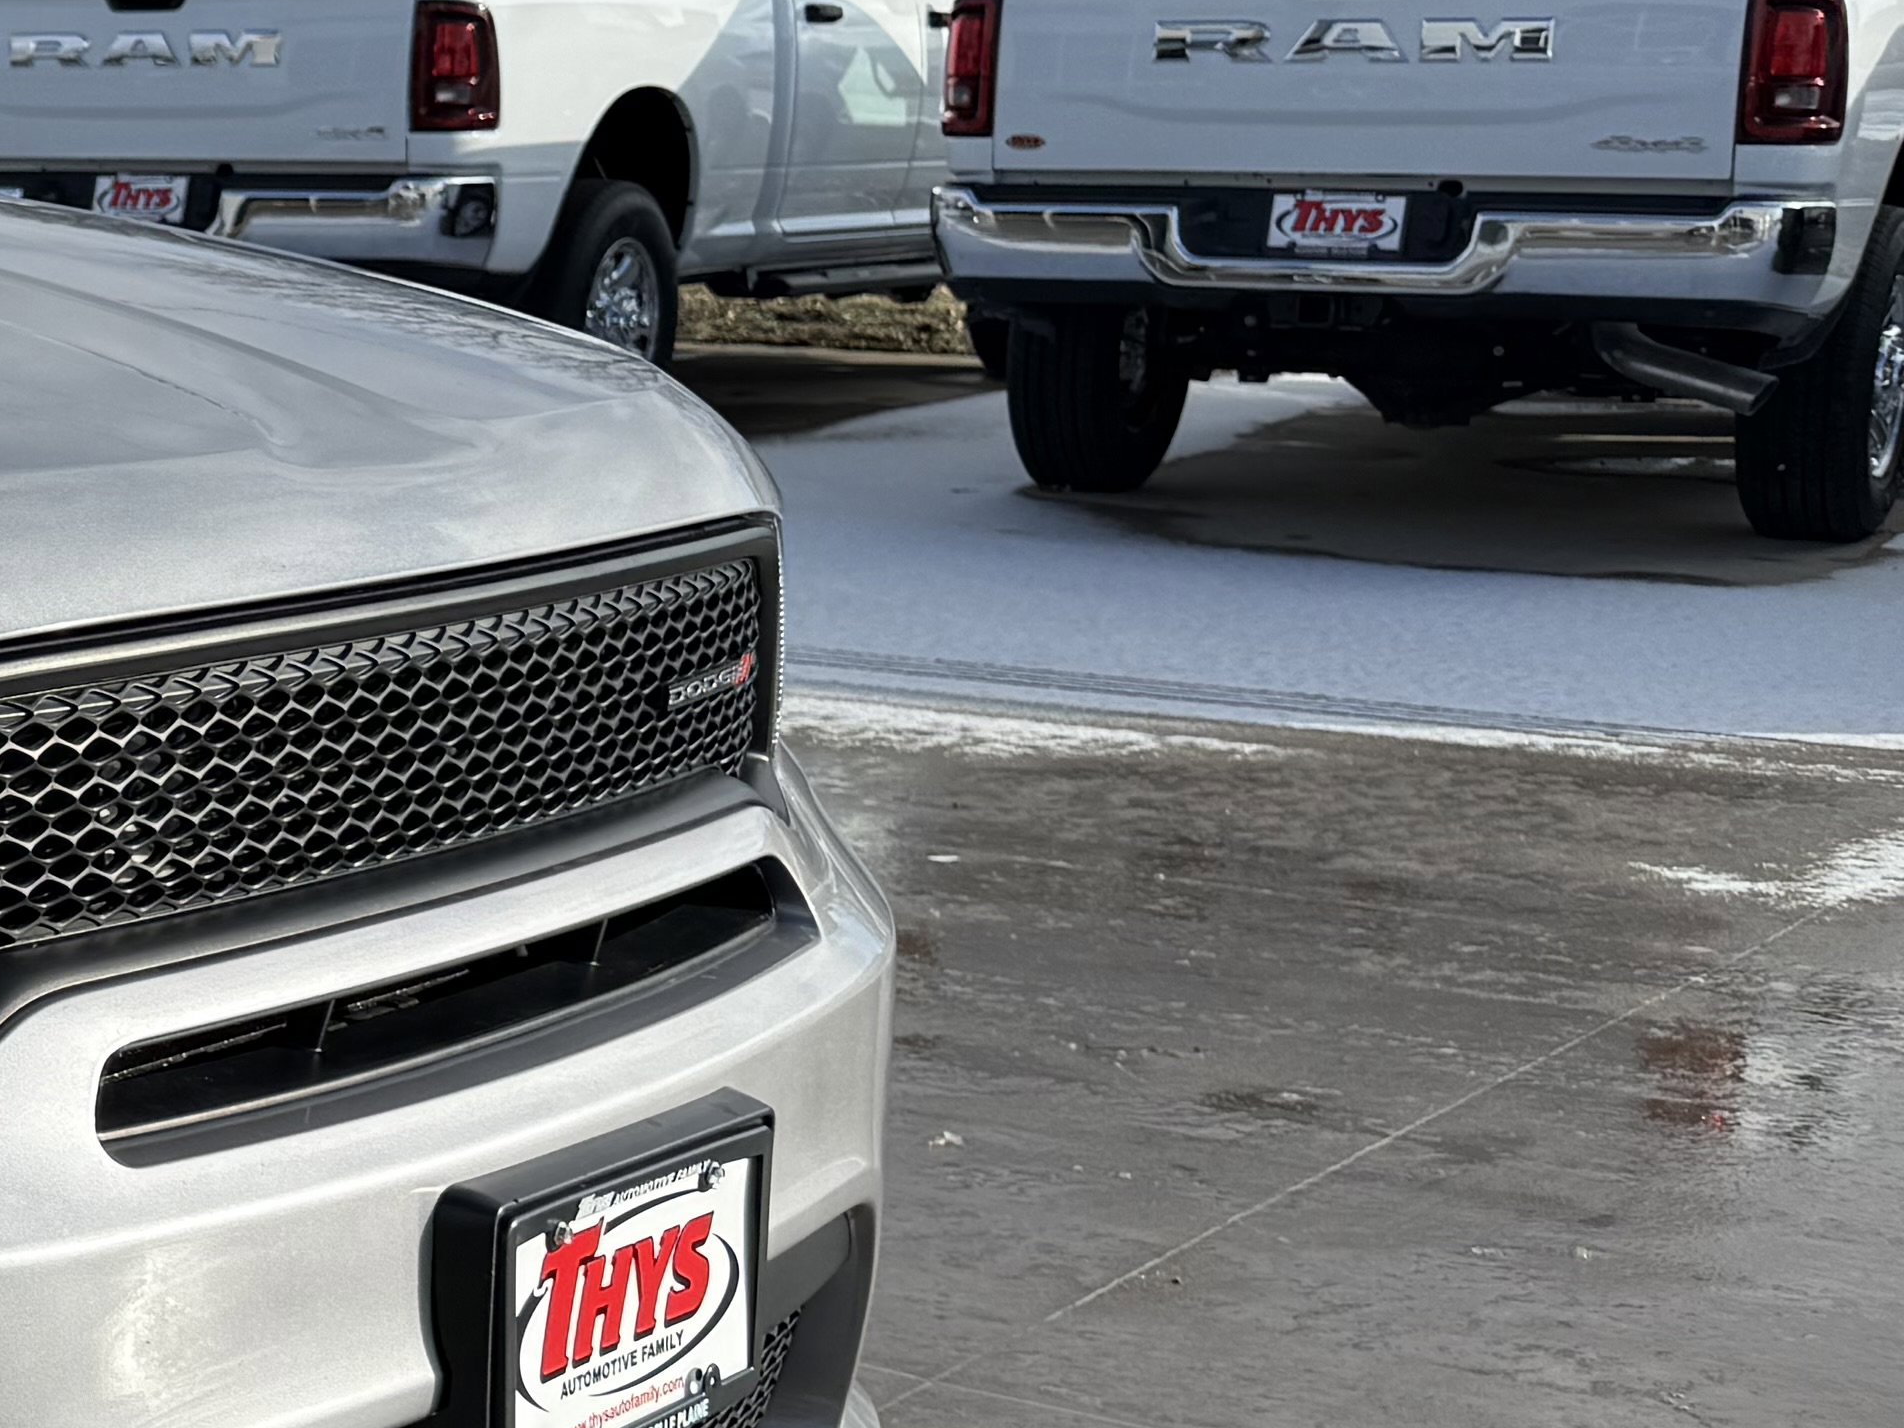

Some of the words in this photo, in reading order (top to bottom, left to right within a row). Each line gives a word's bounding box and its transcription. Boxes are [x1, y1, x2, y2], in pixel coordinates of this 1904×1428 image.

[8, 28, 284, 68] RAM
[1152, 16, 1557, 63] RAM
[1291, 199, 1386, 233] THYS
[540, 1210, 715, 1383] THYS
[560, 1350, 638, 1400] AUTOMOTIVE
[641, 1329, 684, 1363] FAMILY
